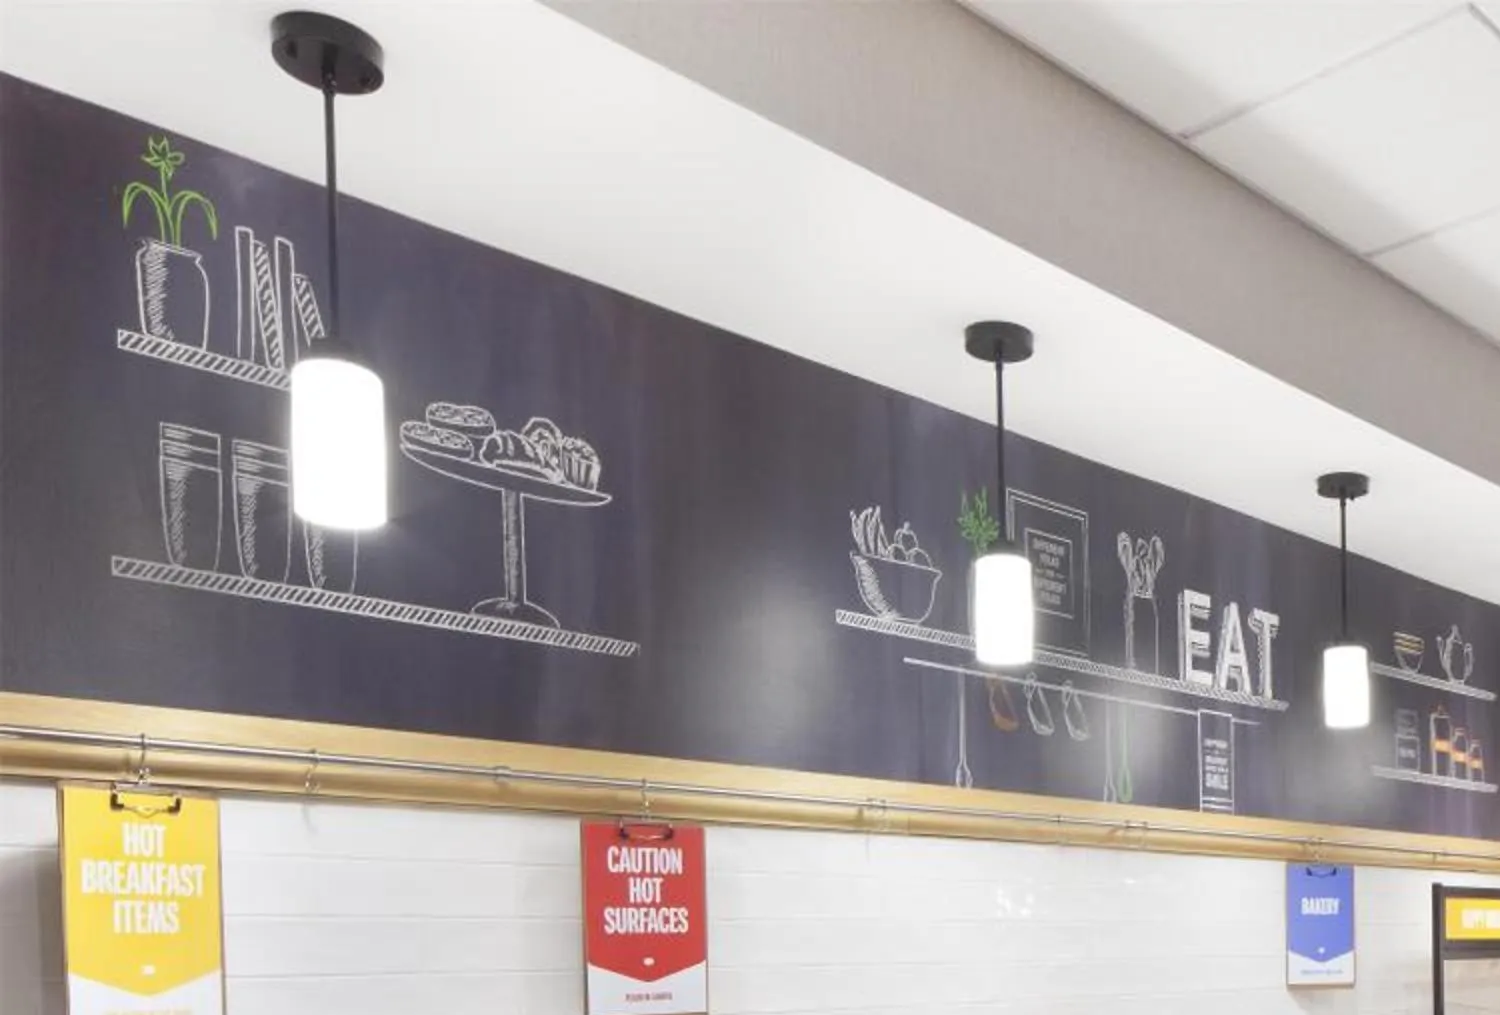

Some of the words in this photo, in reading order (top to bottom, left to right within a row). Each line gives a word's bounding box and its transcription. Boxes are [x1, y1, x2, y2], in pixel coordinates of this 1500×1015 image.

[1178, 588, 1280, 700] EAT
[121, 822, 167, 859] HOT
[80, 859, 206, 897] BREAKFAST
[607, 845, 683, 875] CAUTION
[628, 876, 664, 904] HOT
[112, 899, 181, 935] ITEMS
[603, 906, 689, 935] SURFACES
